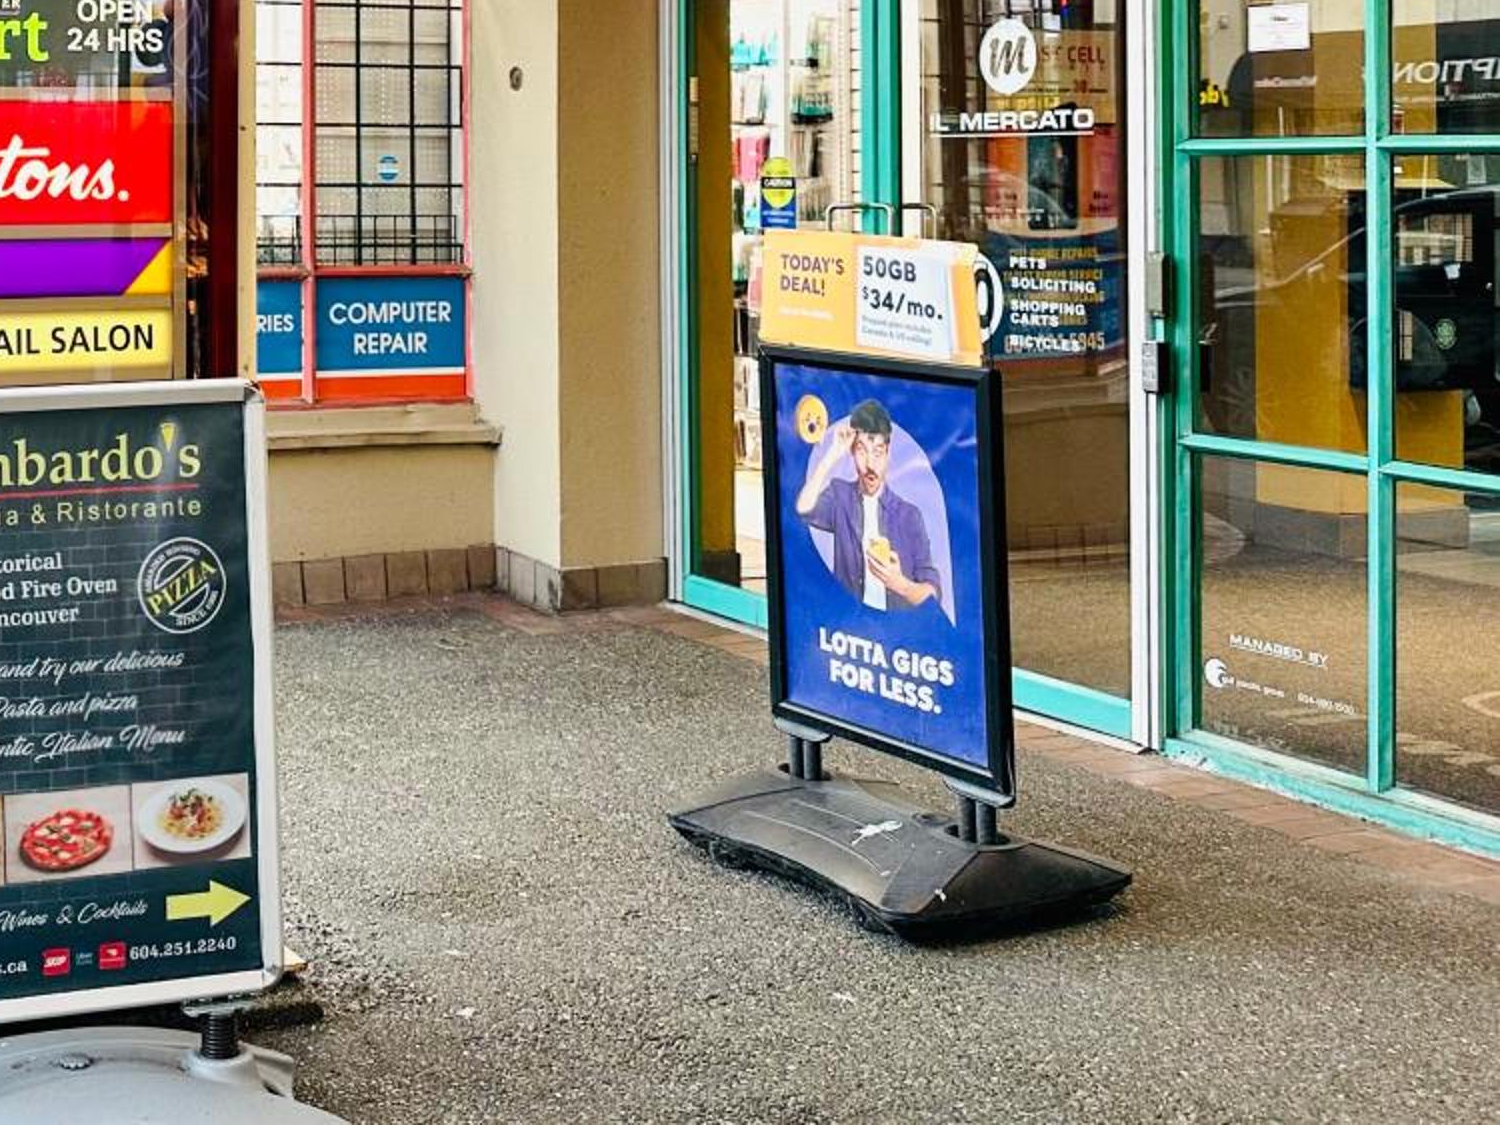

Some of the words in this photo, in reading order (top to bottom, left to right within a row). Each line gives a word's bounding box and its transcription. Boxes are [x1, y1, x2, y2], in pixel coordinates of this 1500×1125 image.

[67, 28, 100, 52] 24
[107, 28, 164, 53] HRS
[930, 112, 950, 132] IL
[959, 108, 1096, 132] MERCATO
[780, 253, 844, 276] TODAY'S
[863, 255, 917, 283] 50GB
[1009, 256, 1047, 270] PETS
[780, 275, 826, 297] DEAL!
[1011, 277, 1097, 293] SOLICITING
[329, 301, 451, 324] COMPUTER
[1009, 298, 1086, 315] SHOPPING
[1009, 313, 1059, 327] CARTS
[51, 324, 156, 353] SALON
[354, 332, 428, 355] REPAIR
[31, 503, 47, 524] &
[56, 498, 202, 524] Ristorante
[21, 579, 62, 599] Fire
[68, 576, 118, 596] Oven
[146, 560, 217, 615] PIZZA
[819, 626, 887, 669] LOTTA
[892, 649, 955, 688] GIGS
[1229, 634, 1303, 659] MANAGED
[38, 657, 68, 686] try
[69, 658, 102, 675] our
[103, 650, 185, 671] delicious
[829, 658, 875, 696] FOR
[880, 675, 942, 715] LESS.
[49, 697, 86, 717] and
[85, 693, 139, 722] pizza
[34, 731, 114, 764] Italian
[120, 725, 186, 752] Menu
[56, 906, 71, 925] &
[77, 900, 149, 925] Cocktails
[129, 935, 237, 961] 604.251.2240
